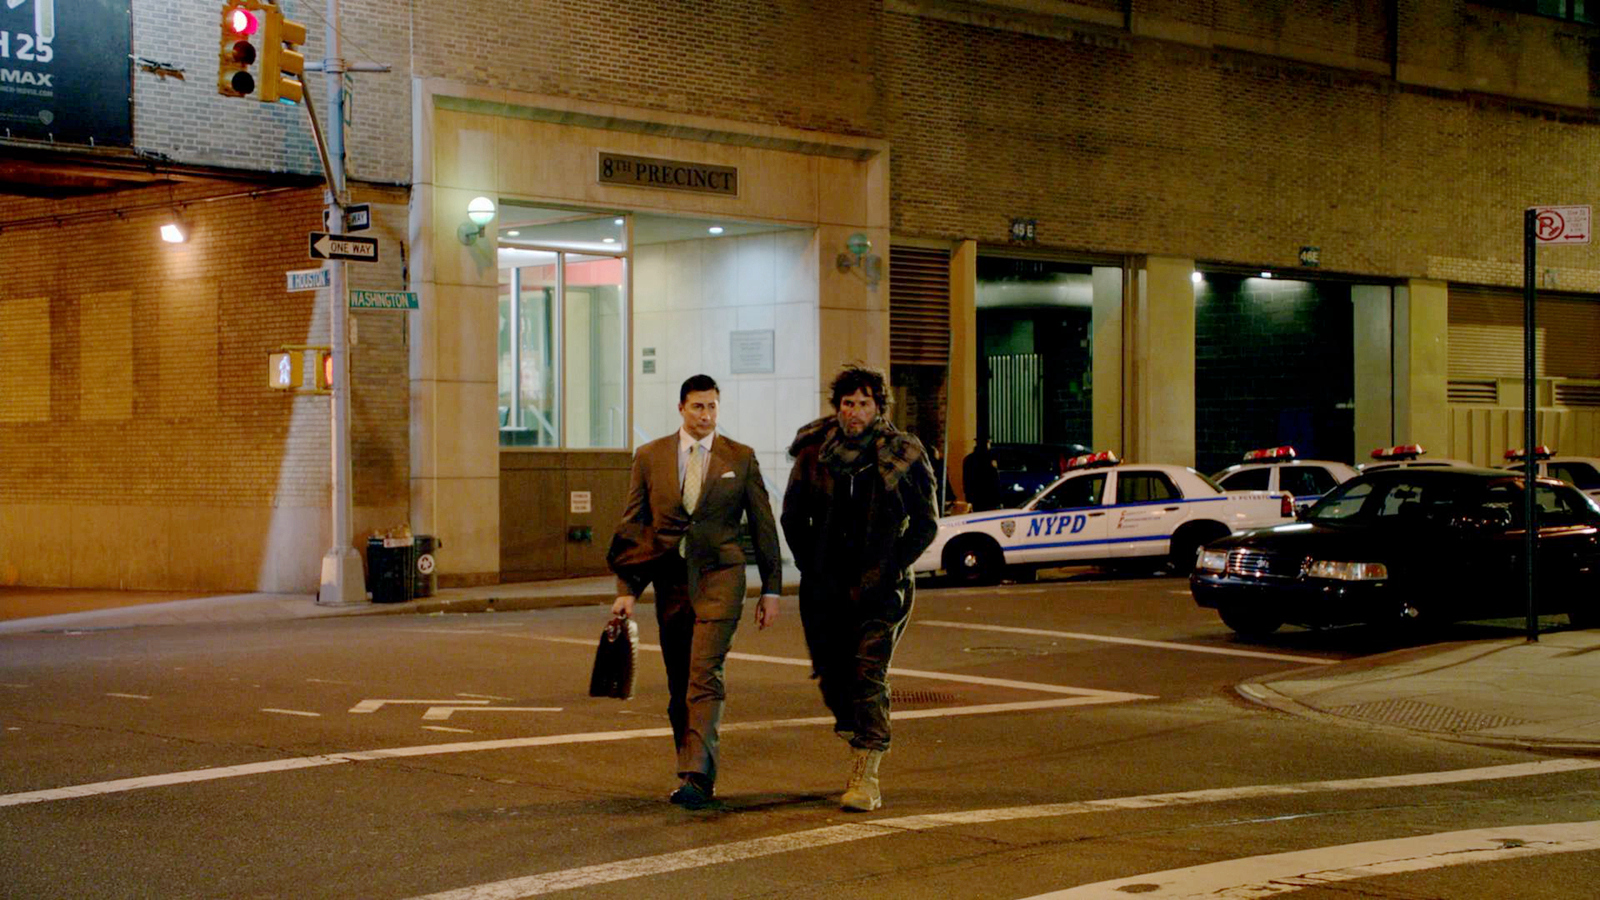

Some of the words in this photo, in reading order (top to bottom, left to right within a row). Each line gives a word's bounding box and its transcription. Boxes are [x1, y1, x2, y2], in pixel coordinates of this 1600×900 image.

[16, 33, 54, 63] 25
[603, 157, 631, 178] 8TH
[636, 162, 733, 190] PRECINCT
[331, 242, 349, 254] ONE
[352, 244, 371, 255] WAY
[296, 270, 326, 288] HOUSTON
[350, 291, 409, 307] WASHINGTON
[1026, 514, 1087, 537] NYPD
